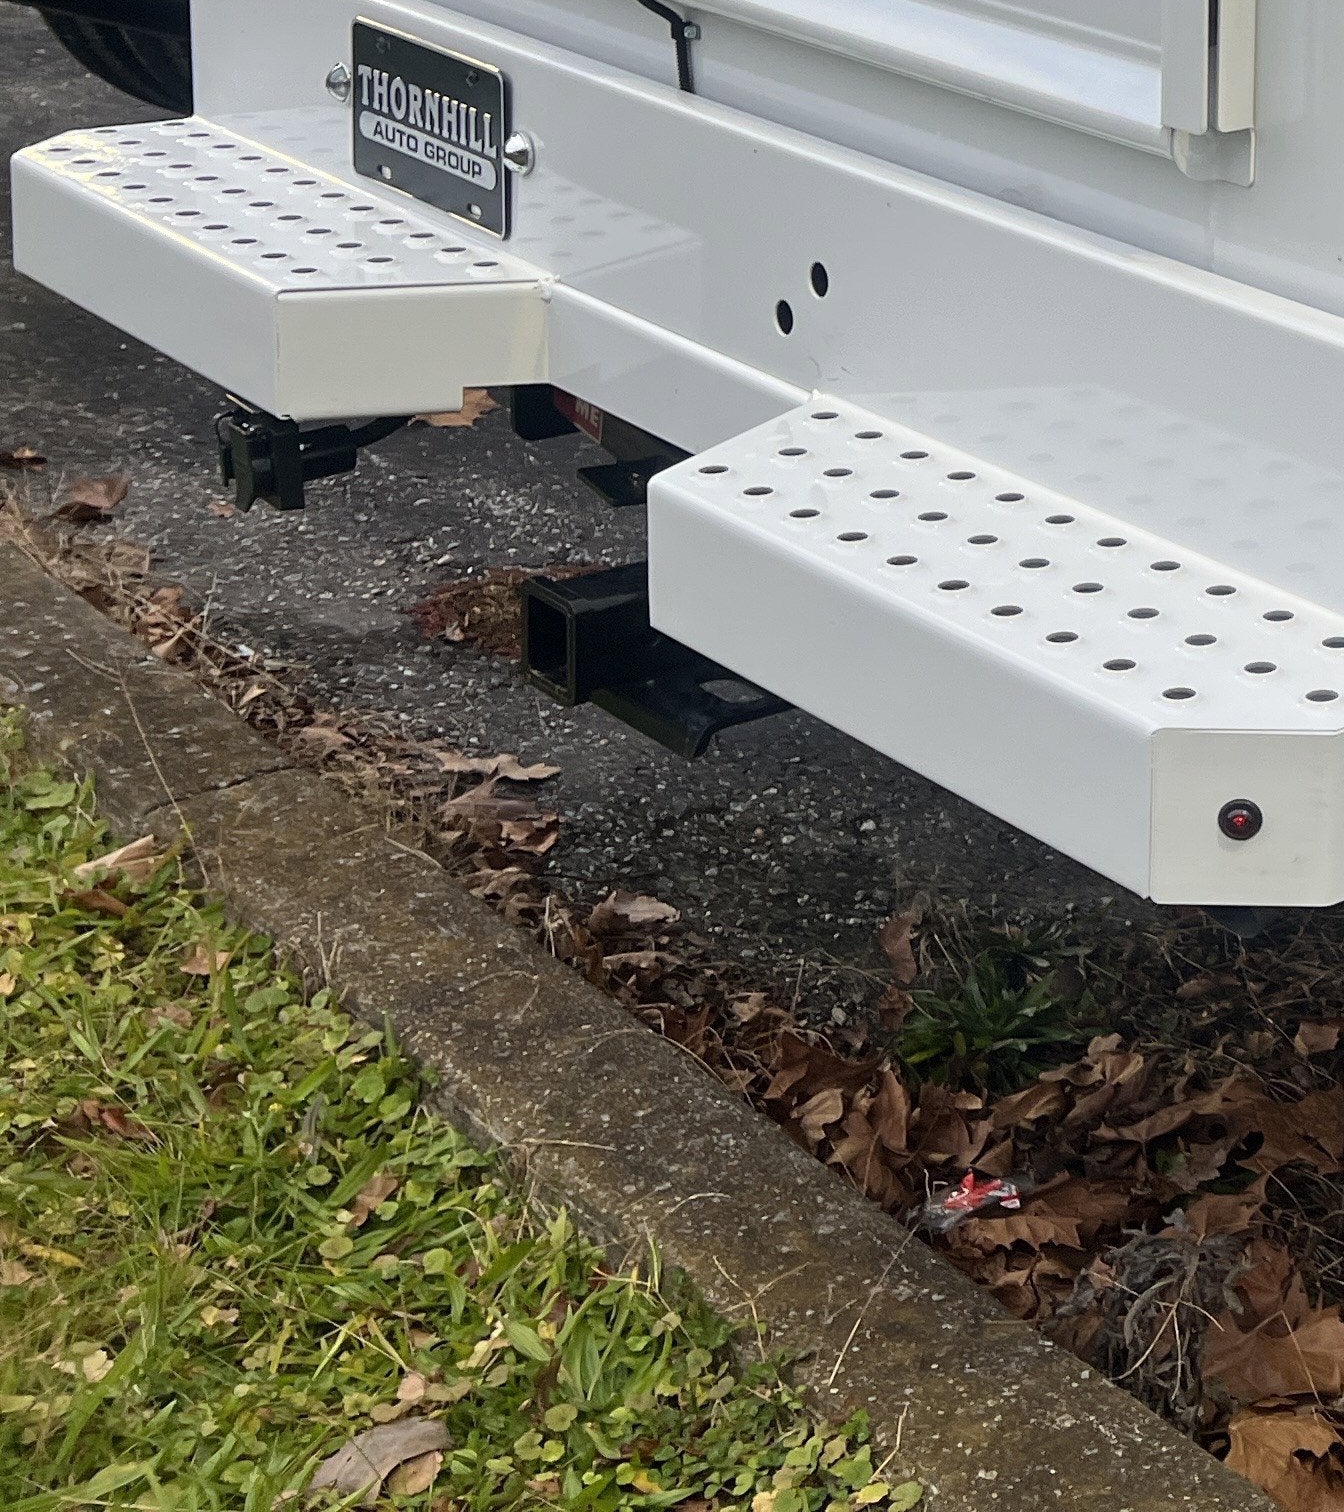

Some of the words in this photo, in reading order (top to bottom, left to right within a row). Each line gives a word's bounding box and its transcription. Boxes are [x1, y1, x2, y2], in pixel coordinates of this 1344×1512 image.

[356, 63, 499, 160] THORNHILL
[372, 119, 420, 153] AUTO
[424, 140, 483, 179] GROUP
